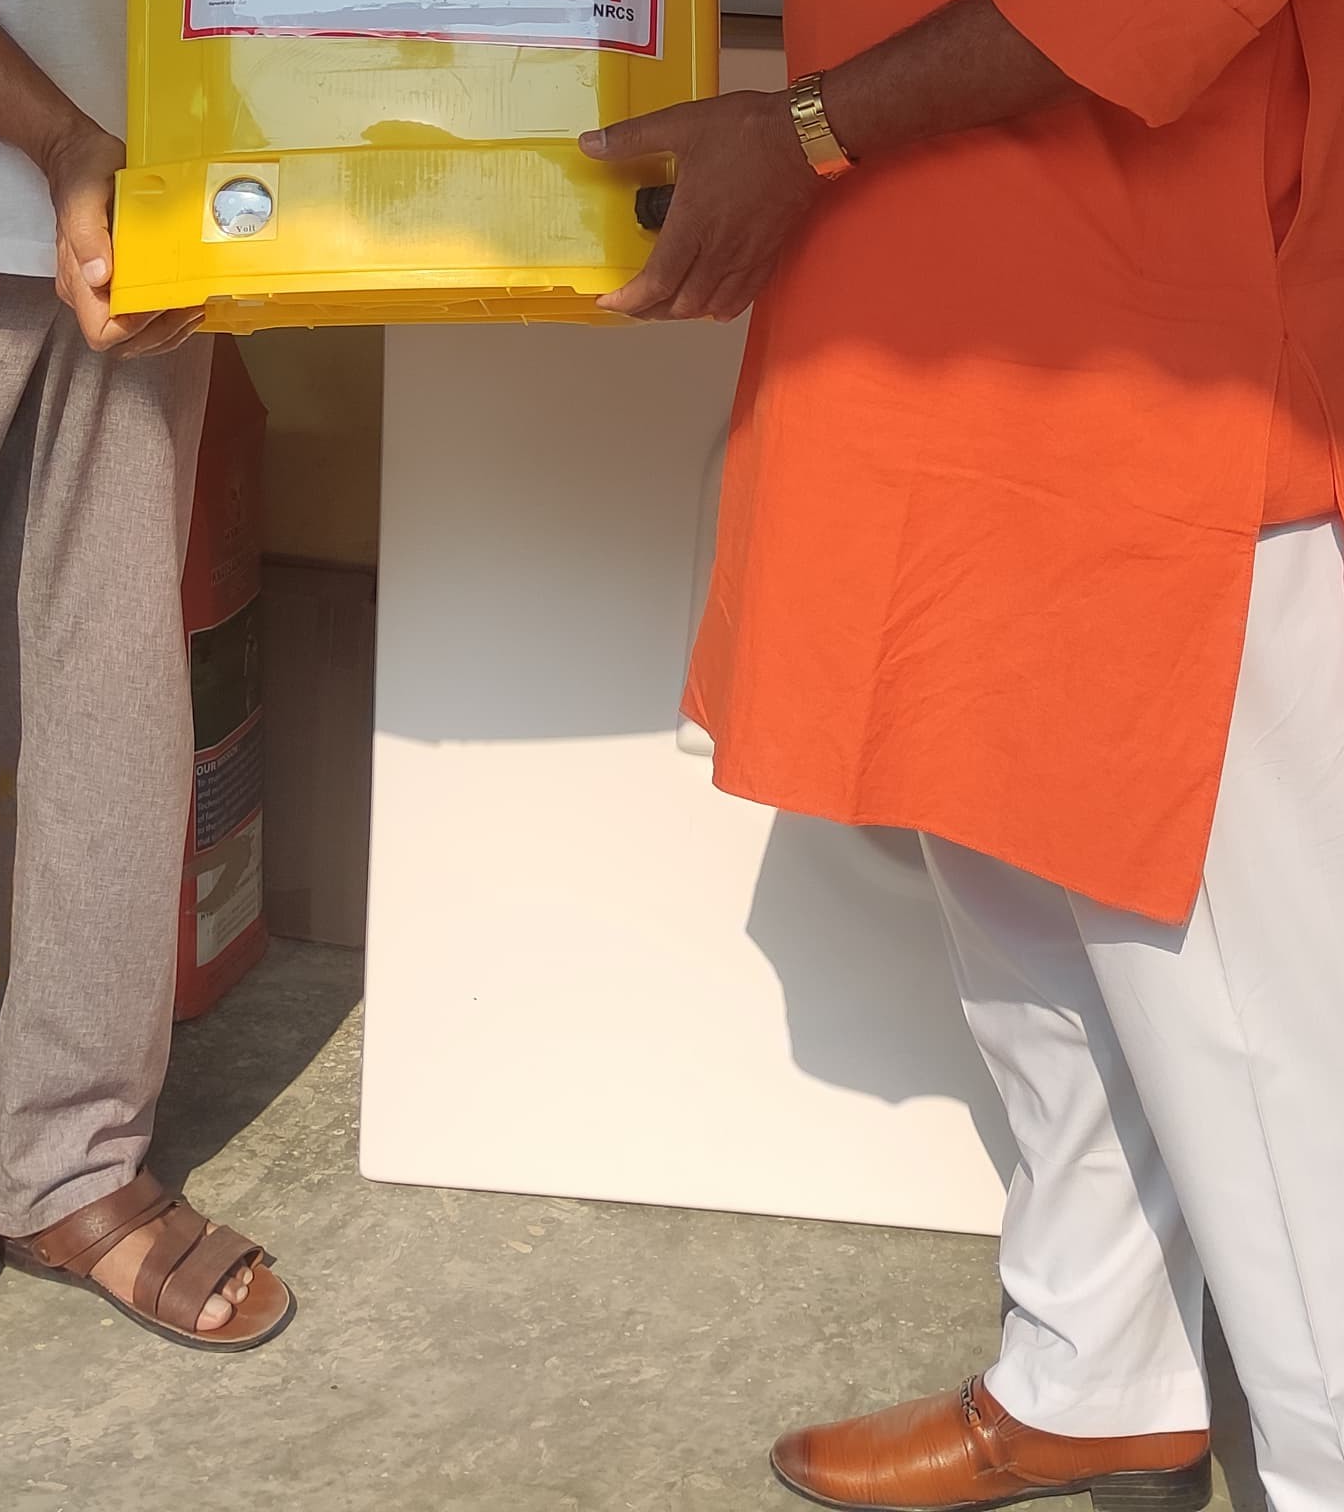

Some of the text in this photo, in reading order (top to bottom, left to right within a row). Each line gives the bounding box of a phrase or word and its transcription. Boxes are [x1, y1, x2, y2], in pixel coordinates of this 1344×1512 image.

[593, 3, 634, 22] NRCS
[236, 224, 256, 233] Volt
[196, 760, 217, 777] OUR
